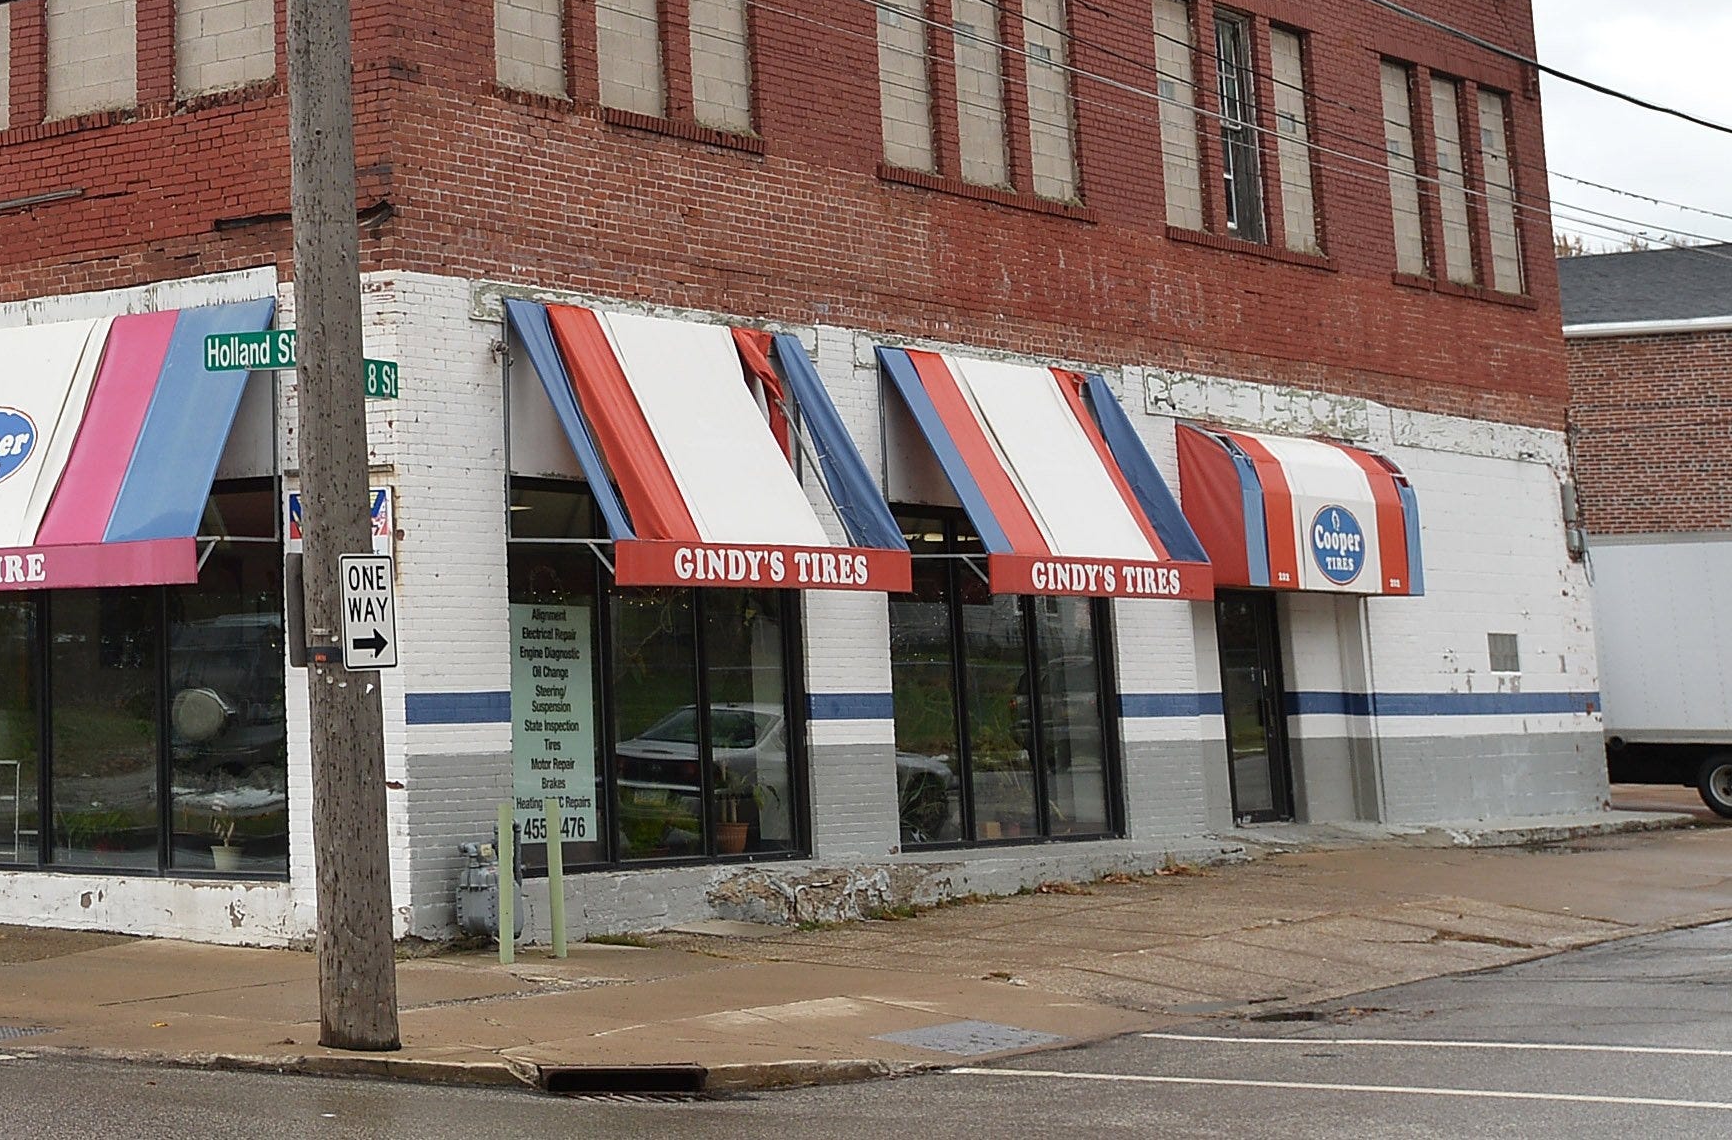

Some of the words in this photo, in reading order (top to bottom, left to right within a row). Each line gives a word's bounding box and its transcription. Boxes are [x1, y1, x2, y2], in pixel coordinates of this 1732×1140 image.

[207, 335, 270, 368] Holland
[278, 333, 297, 362] St
[381, 369, 396, 395] St
[1315, 525, 1360, 556] Cooper
[674, 547, 786, 582] GINDY'S
[794, 551, 868, 586] TIRES
[1326, 556, 1354, 571] TIRES
[349, 566, 386, 591] ONE
[1032, 561, 1116, 593] GINDY'S
[1124, 565, 1181, 596] TIRES
[348, 597, 388, 622] WAY
[532, 609, 566, 622] Alignment
[522, 627, 553, 640] Electrical
[555, 628, 576, 641] Repair
[520, 647, 543, 660] Engine
[545, 647, 580, 660] Diagnostic
[532, 666, 541, 677] Oil
[543, 666, 568, 679] Change
[536, 685, 566, 699] Steering/
[532, 701, 571, 714] Suspension
[524, 720, 543, 732] State
[544, 721, 579, 733] Inspection
[545, 739, 561, 751] Tires
[531, 758, 551, 770] Motor
[553, 759, 575, 770] Repair
[542, 778, 565, 789] Brakes
[517, 797, 543, 811] Heating
[565, 797, 591, 810] Repairs
[524, 817, 585, 839] 455476
